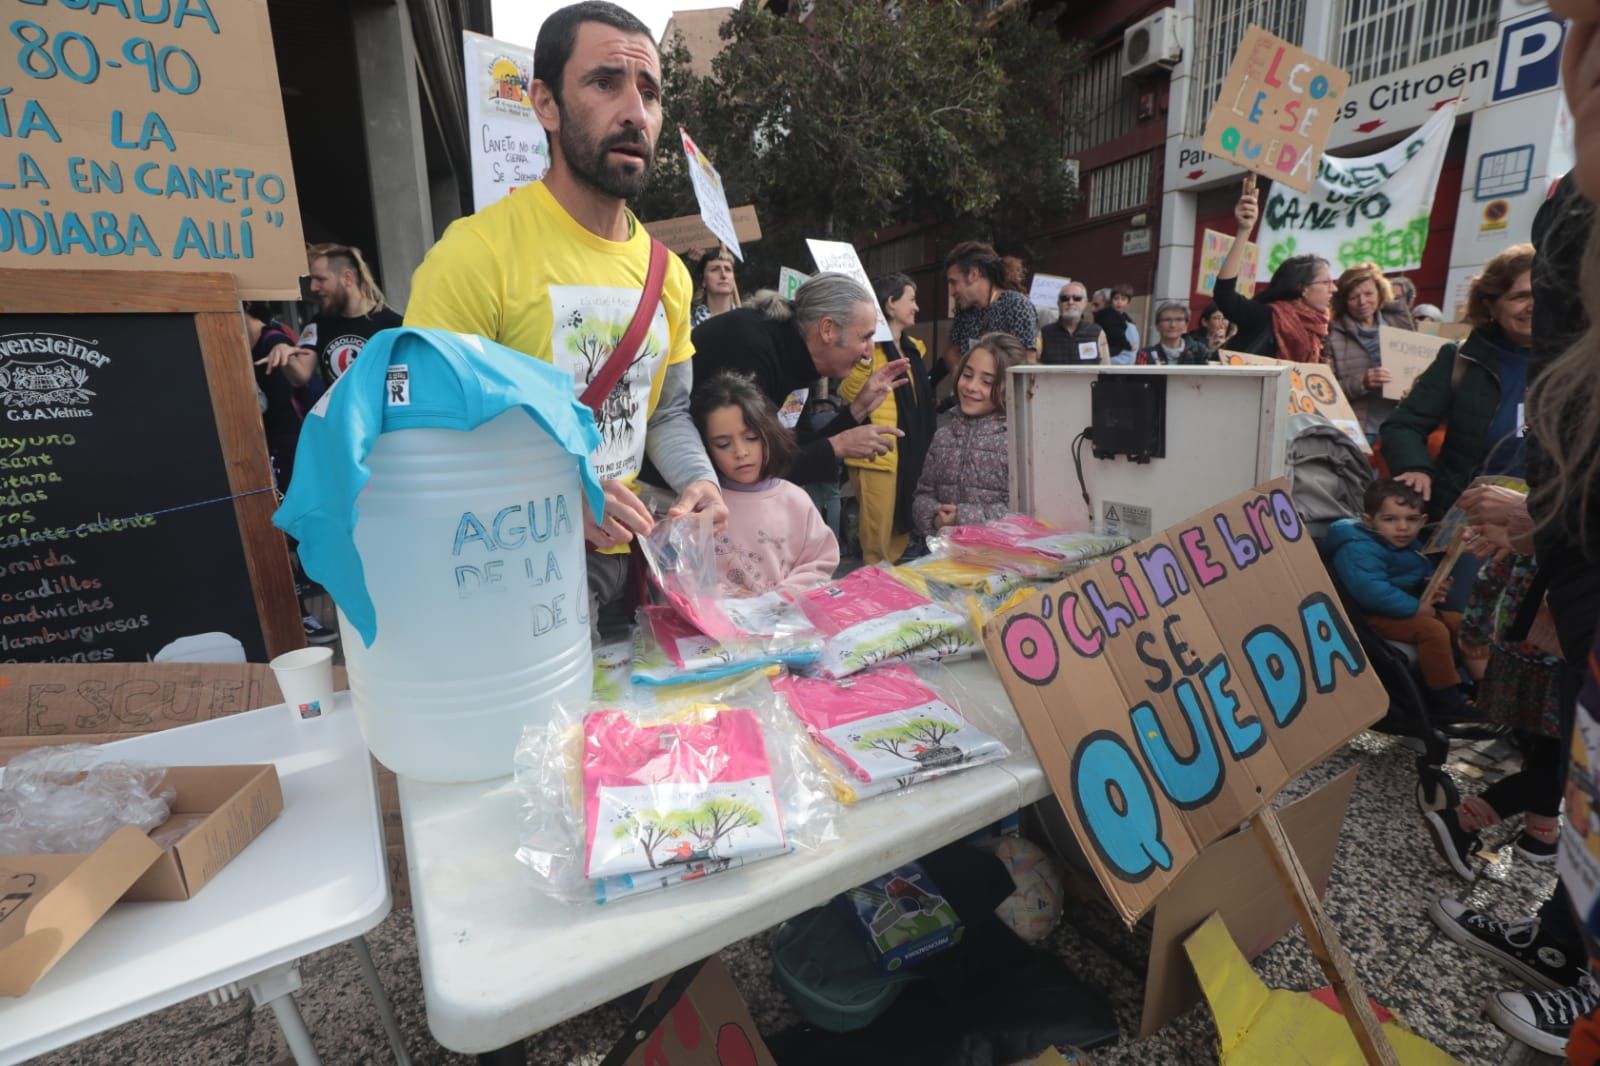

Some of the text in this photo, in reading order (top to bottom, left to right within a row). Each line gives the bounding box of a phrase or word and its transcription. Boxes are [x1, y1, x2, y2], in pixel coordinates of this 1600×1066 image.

[9, 20, 201, 95] 80-90
[1500, 21, 1564, 91] P
[1369, 59, 1489, 112] Citroën
[110, 110, 176, 152] LA
[1220, 126, 1314, 182] QUEDA
[67, 156, 124, 194] EN
[133, 162, 286, 204] CANETO
[1266, 192, 1392, 231] CANETO
[452, 494, 573, 556] AGUA
[532, 593, 567, 637] DE
[1135, 614, 1204, 694] SE
[1070, 591, 1366, 884] QUEDA
